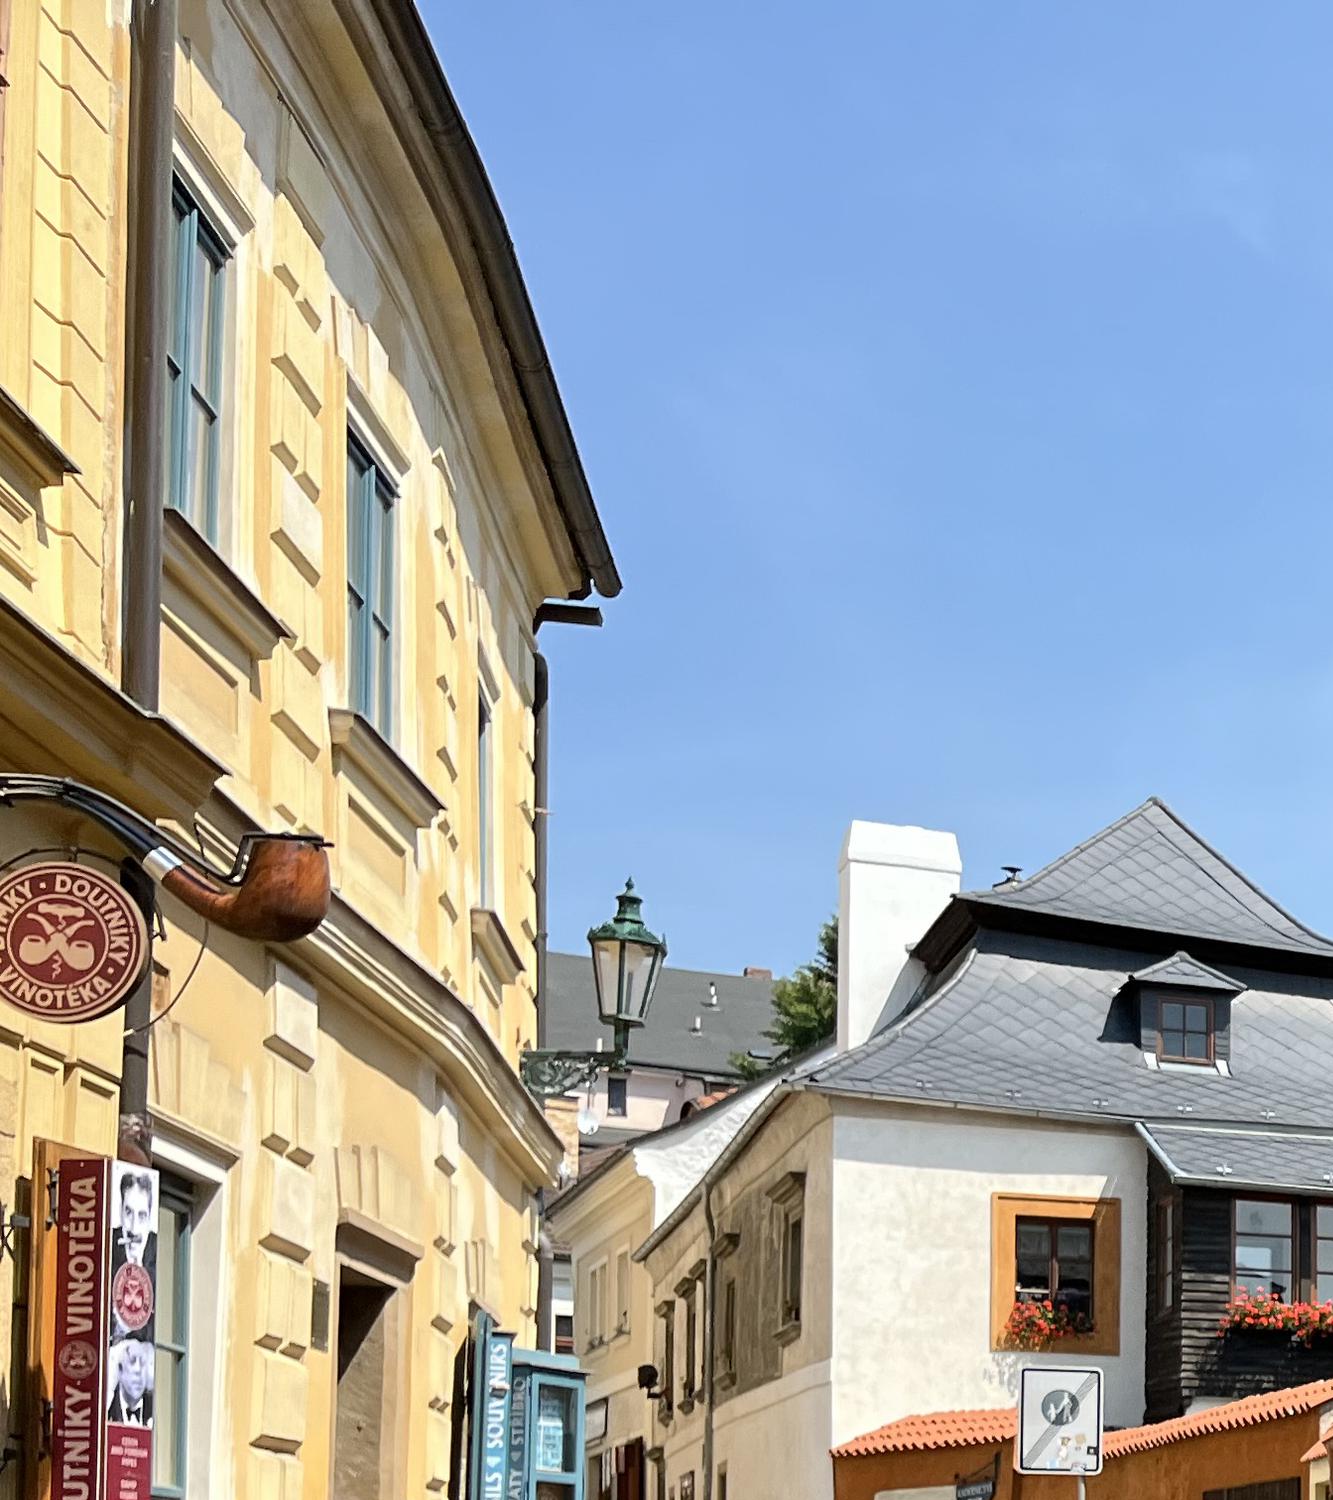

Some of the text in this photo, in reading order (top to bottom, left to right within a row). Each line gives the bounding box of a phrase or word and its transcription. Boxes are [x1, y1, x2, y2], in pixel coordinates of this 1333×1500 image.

[0, 965, 112, 1008] VINOTÉKA
[63, 1177, 96, 1335] VINOTÉKA
[487, 1343, 508, 1449] SOUVNIRS
